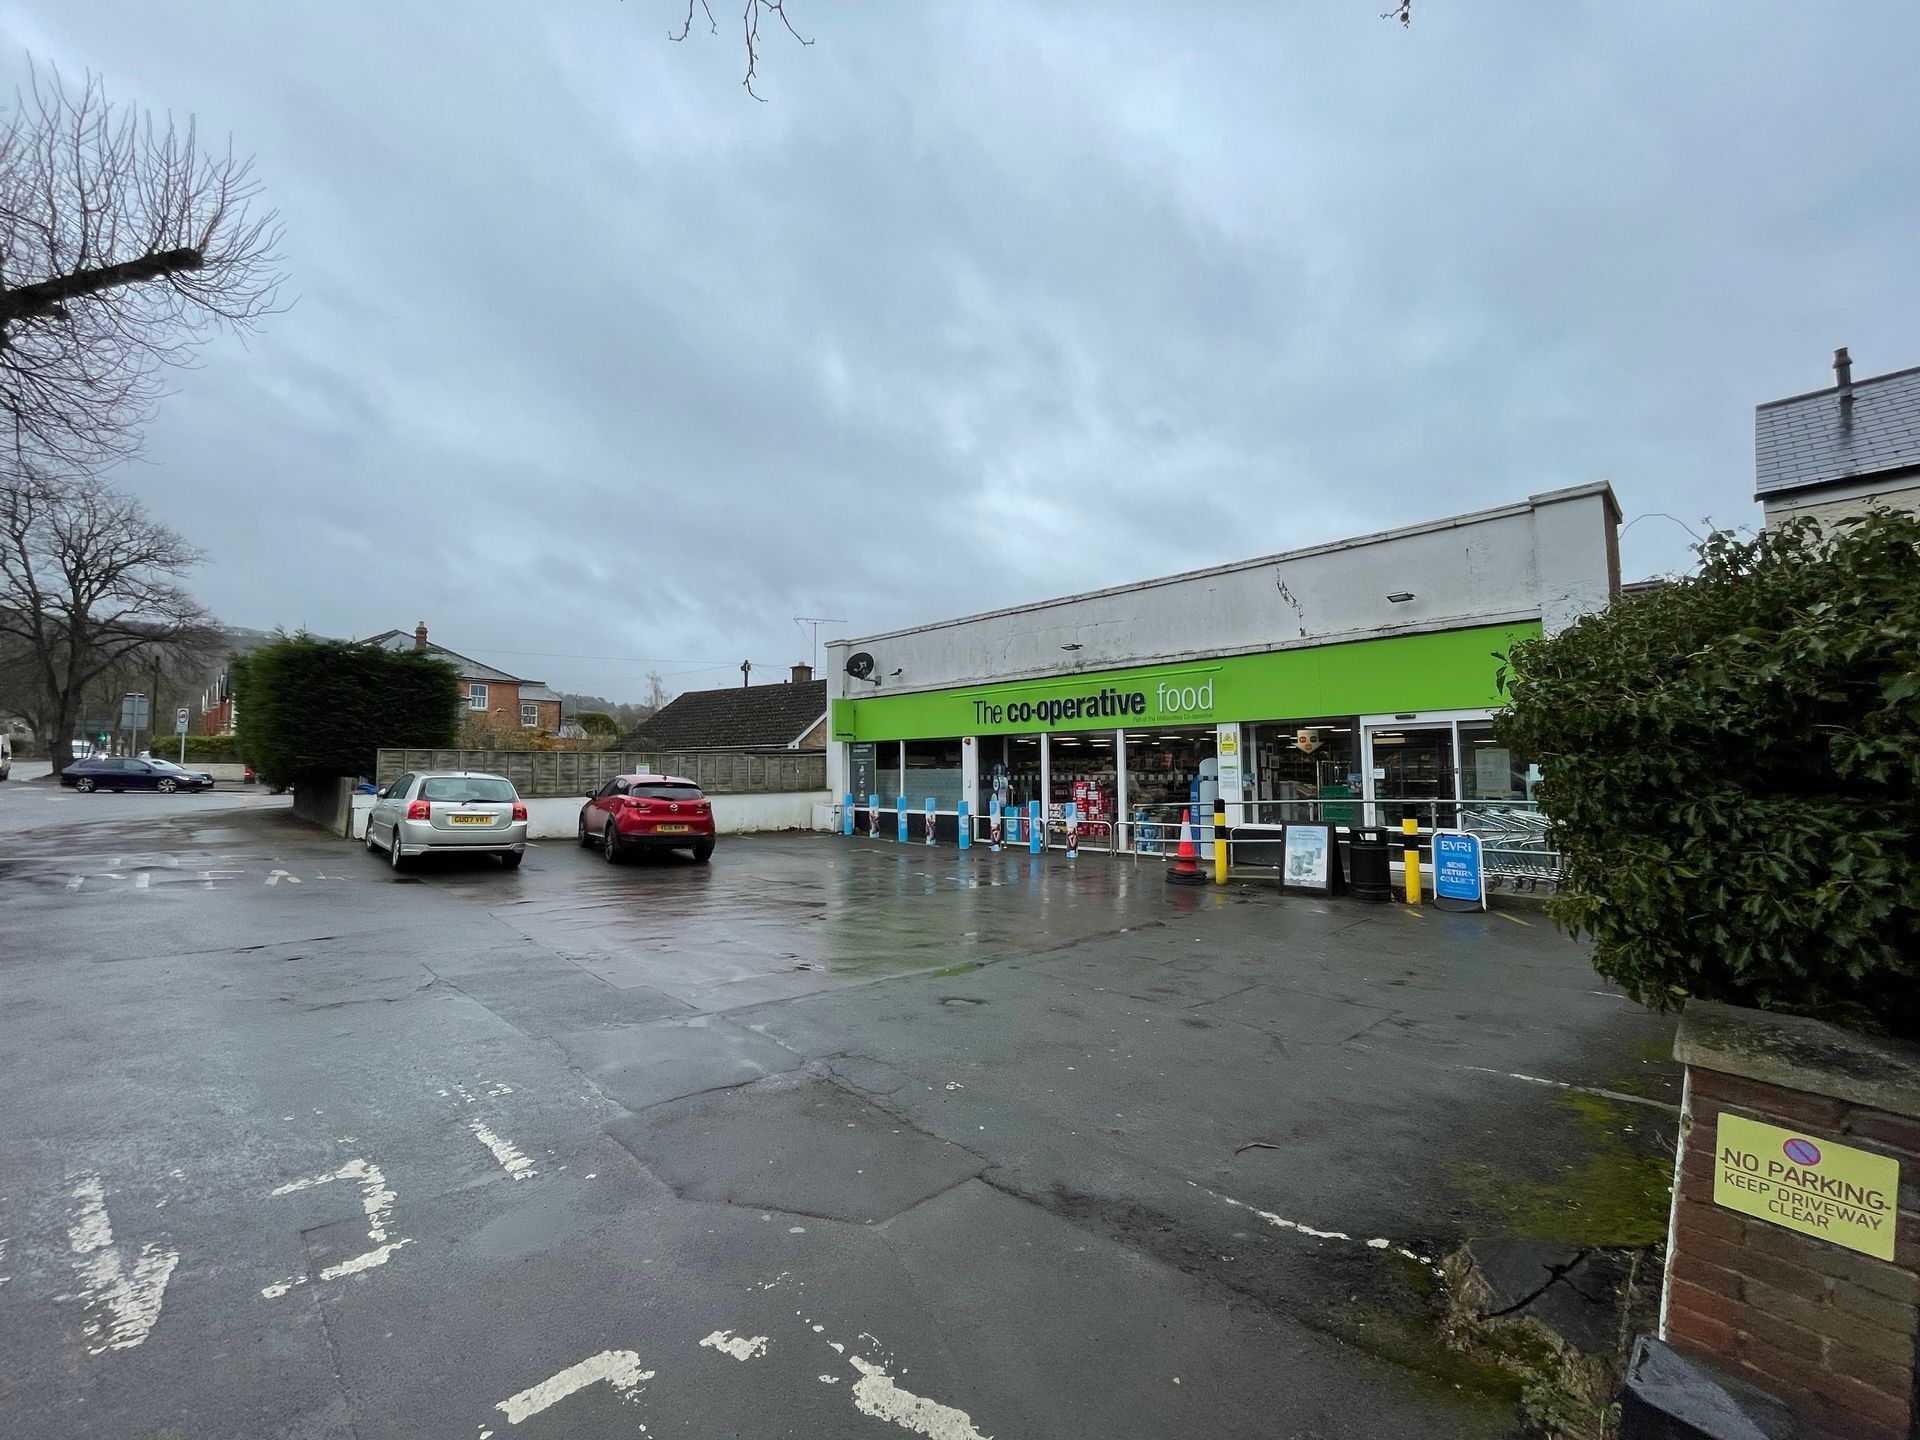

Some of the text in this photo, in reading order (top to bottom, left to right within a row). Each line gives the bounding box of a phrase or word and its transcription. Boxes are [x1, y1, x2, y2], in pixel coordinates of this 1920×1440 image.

[973, 678, 1214, 726] The co-operative food
[1440, 875, 1475, 885] COLLECT
[1441, 868, 1473, 877] RETURN
[1724, 1147, 1885, 1210] NO PARKING
[1724, 1171, 1883, 1230] KEEP DRIVEWAY
[1768, 1200, 1829, 1230] CLEAR
